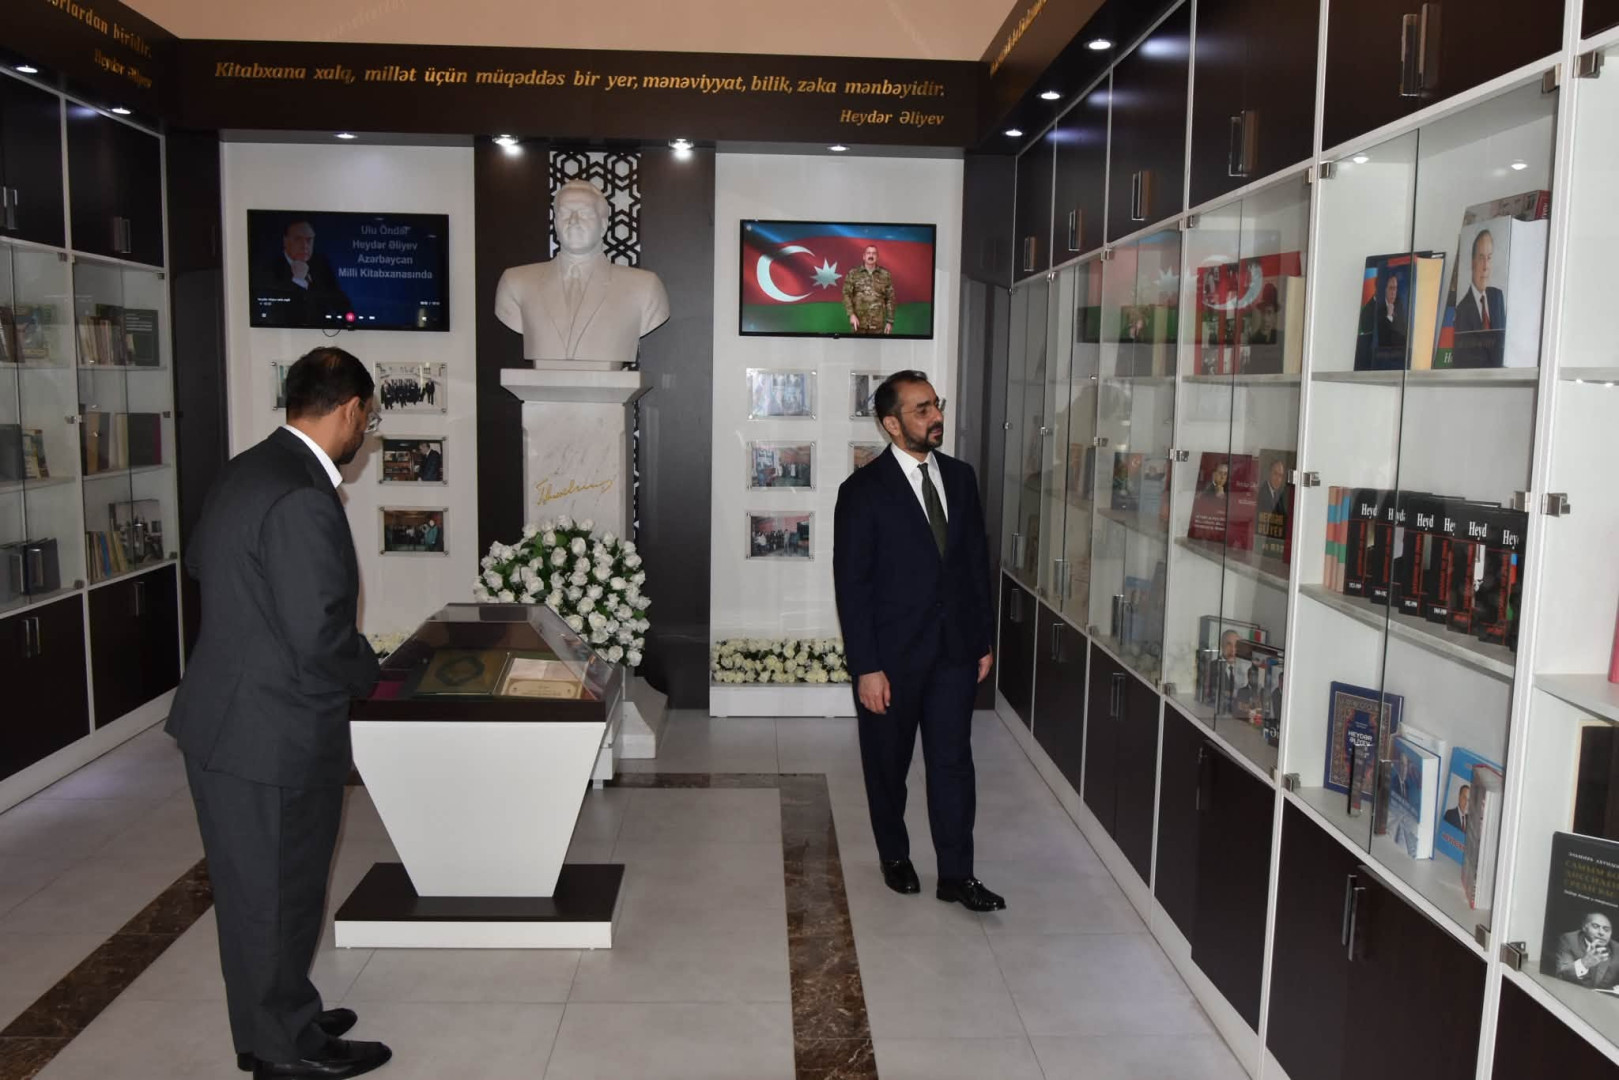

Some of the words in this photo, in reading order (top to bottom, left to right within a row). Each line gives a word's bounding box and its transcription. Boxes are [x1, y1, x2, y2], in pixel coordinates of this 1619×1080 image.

[215, 62, 307, 79] Kitabxana
[313, 65, 356, 84] xalq,
[364, 66, 417, 82] millət
[424, 68, 468, 86] üçün
[475, 69, 566, 88] müqəddəs
[574, 71, 600, 86] bir
[605, 75, 639, 91] yer,
[642, 75, 747, 93] mənəviyyat,
[751, 76, 793, 93] bilik,
[797, 78, 836, 93] zəka
[844, 80, 945, 98] mənbəyidir.
[840, 110, 893, 127] Heydər
[899, 111, 944, 128] Əliyev
[361, 225, 378, 236] Ulu
[388, 240, 419, 253] Əliyev
[338, 268, 358, 279] Milli
[360, 269, 433, 280] Kitabxanasında
